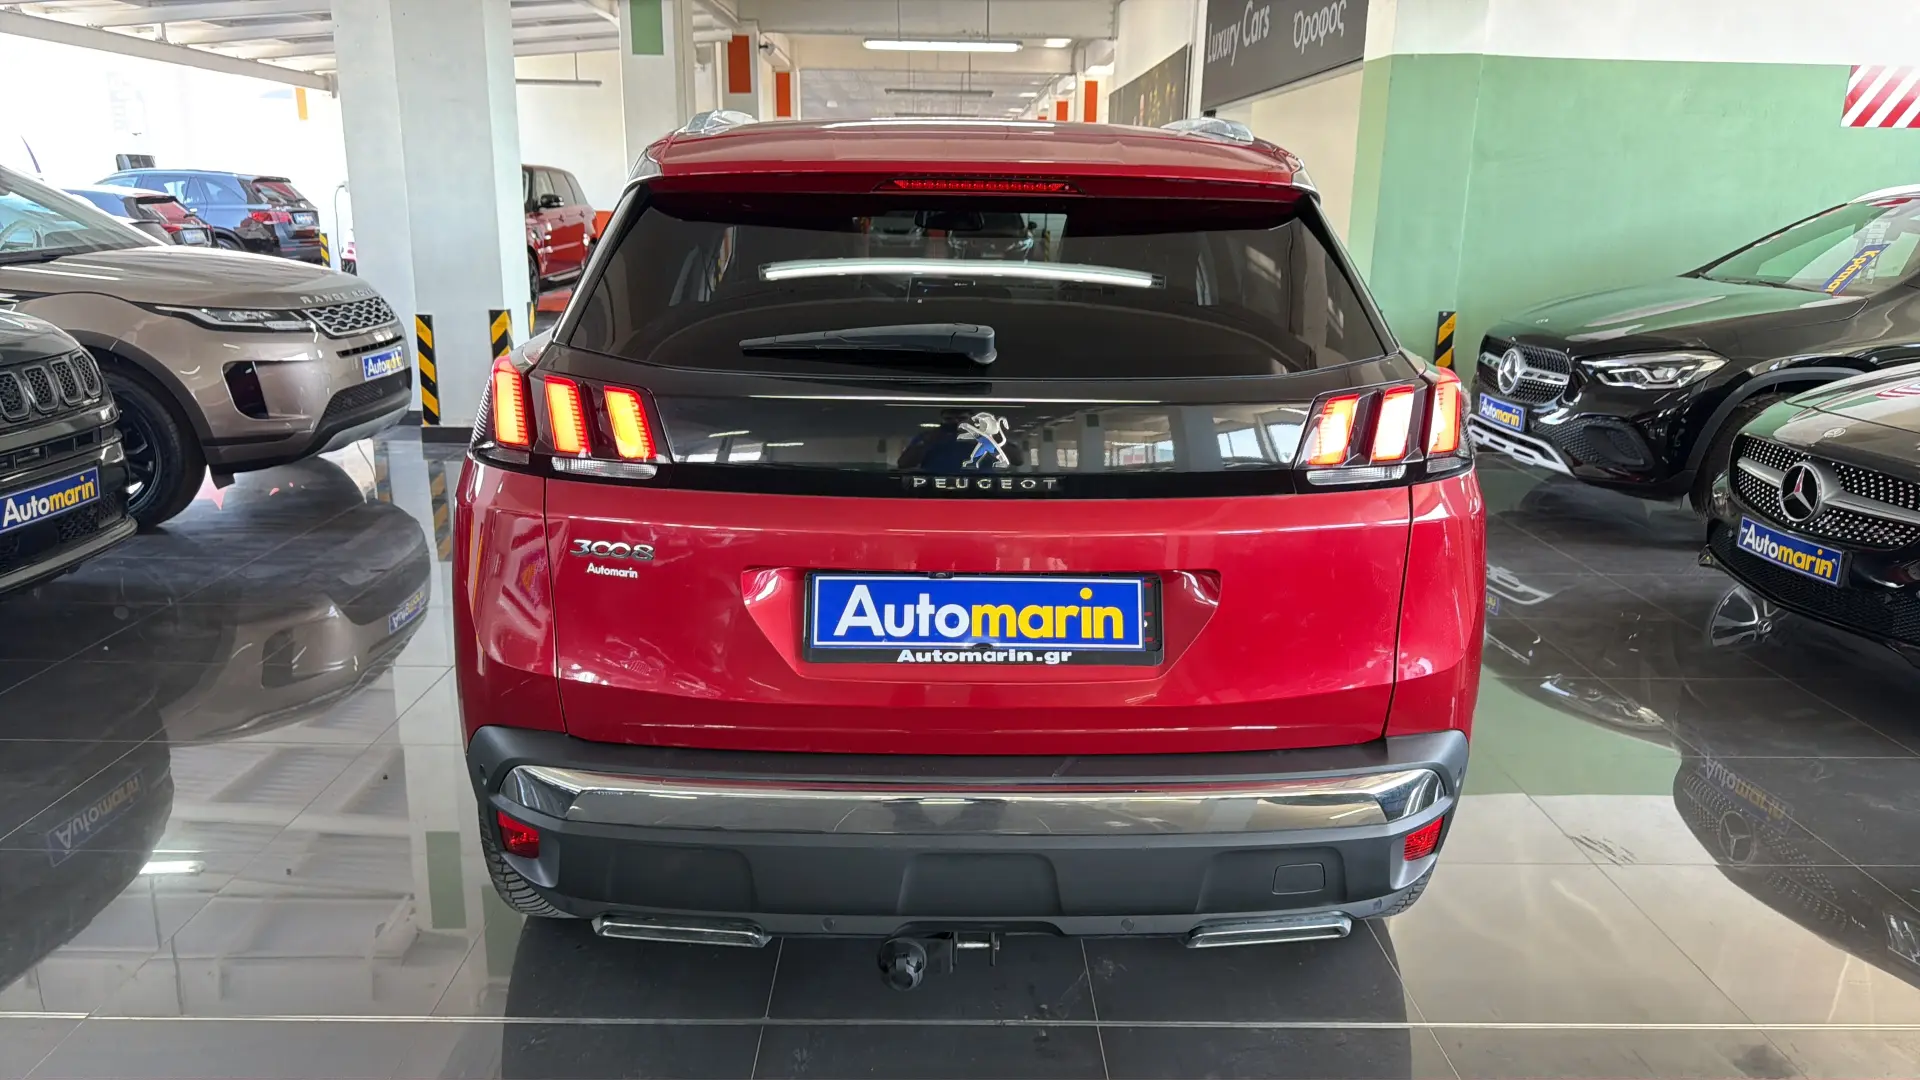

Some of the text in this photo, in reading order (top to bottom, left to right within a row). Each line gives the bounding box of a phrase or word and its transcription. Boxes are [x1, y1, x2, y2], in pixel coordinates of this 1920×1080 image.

[1207, 1, 1270, 66] Luxury Cars
[1293, 1, 1347, 54] Όροφος
[300, 292, 348, 304] RANGE
[1481, 397, 1519, 427] Automarin
[913, 477, 1057, 489] PEUGEOT
[3, 476, 95, 527] Automarin
[570, 539, 654, 560] 3008
[1743, 524, 1833, 578] Automarin
[586, 562, 638, 578] Automarin
[833, 584, 1124, 639] Automarin
[897, 649, 1073, 664] Automarin.gr
